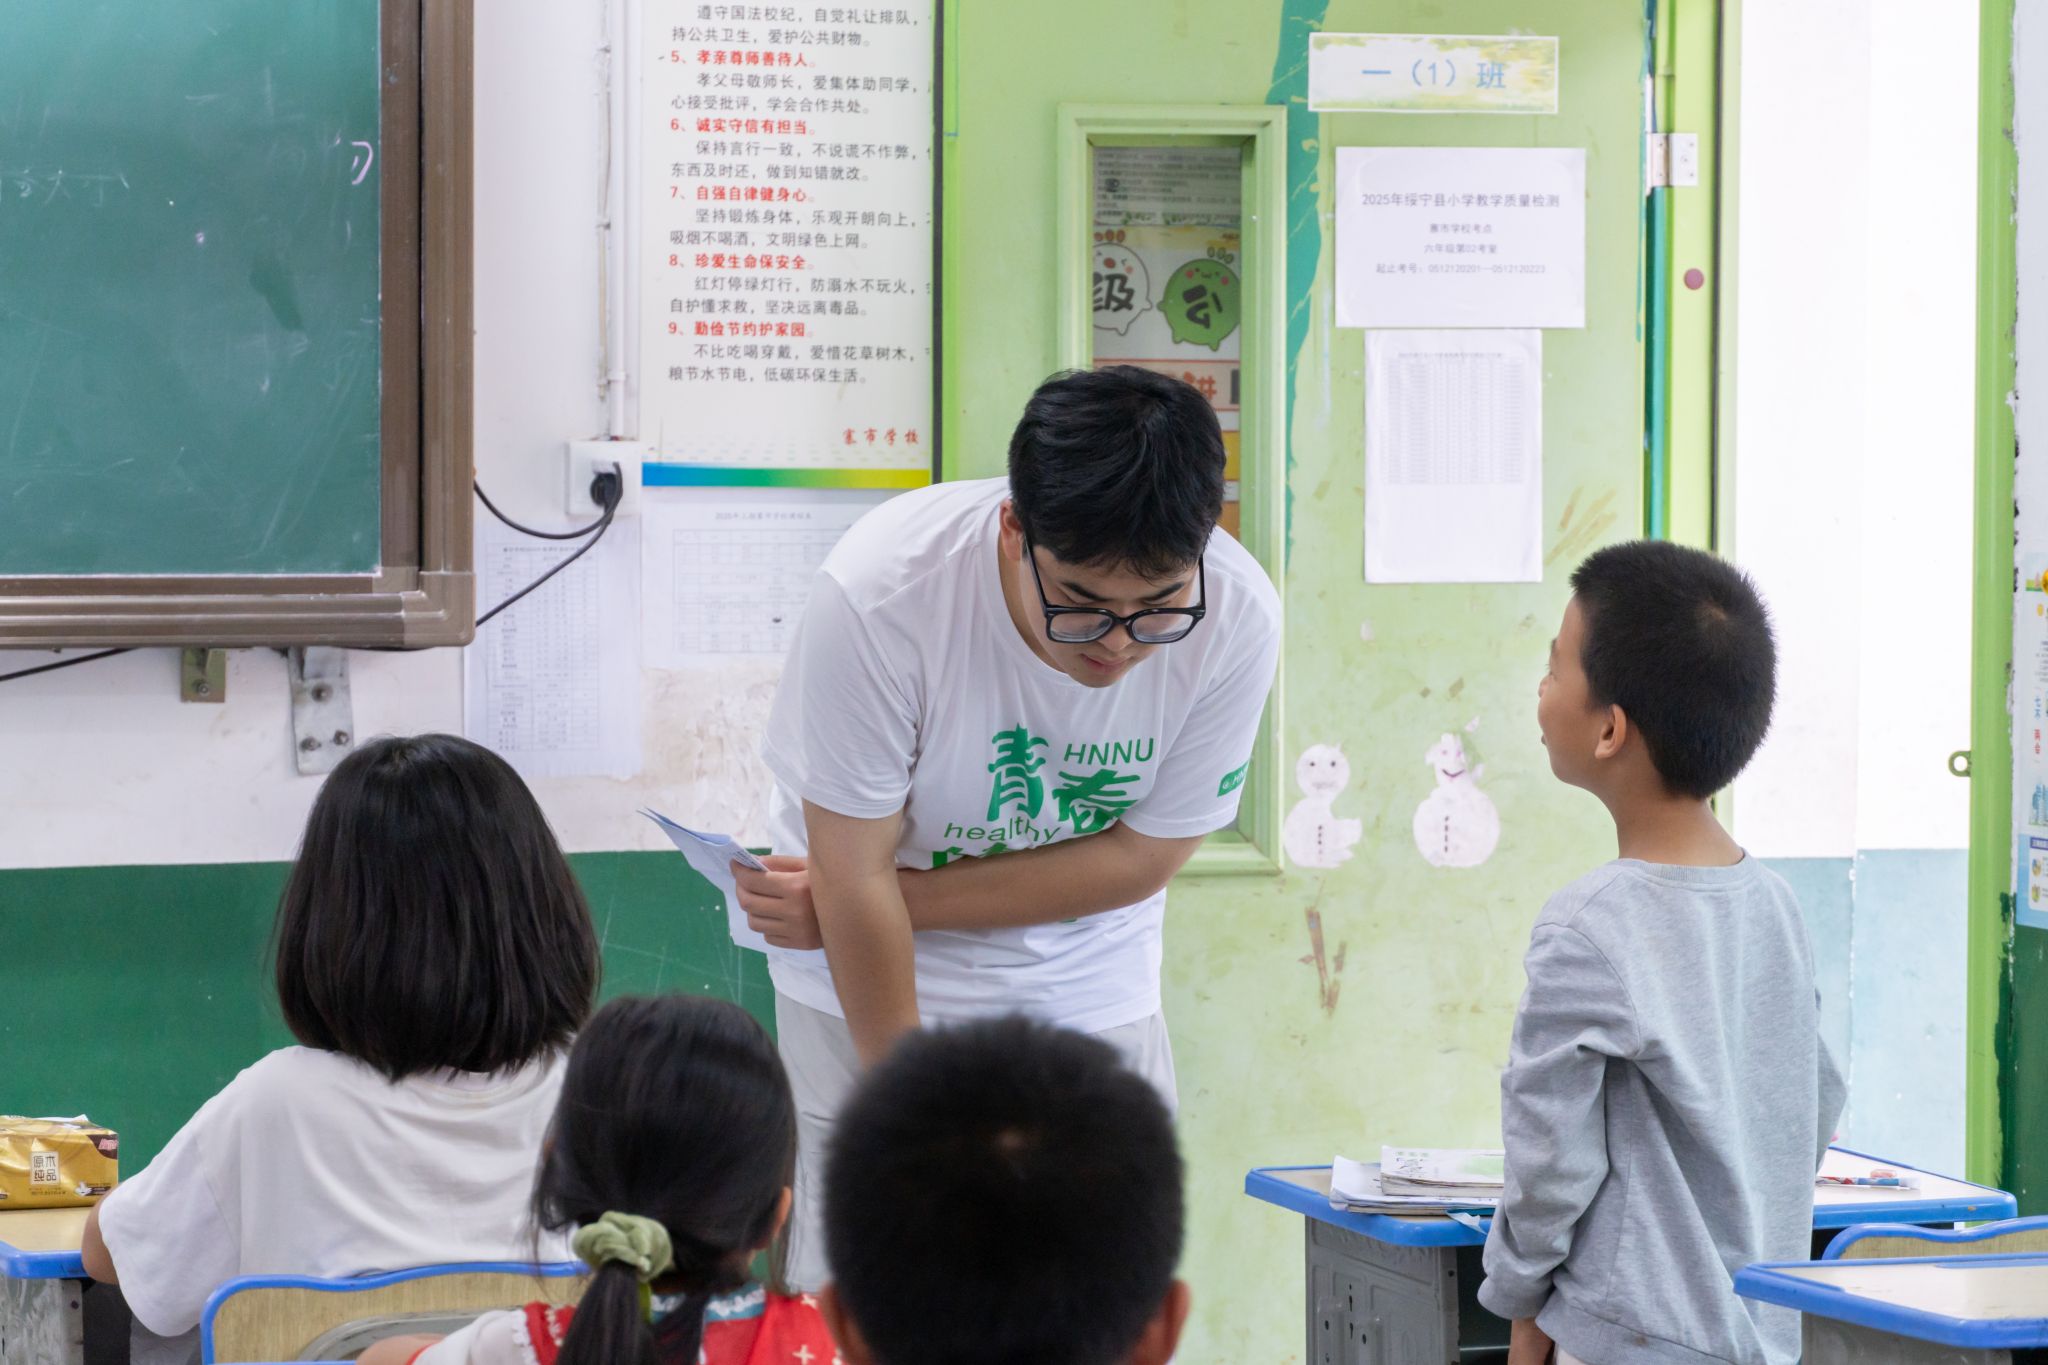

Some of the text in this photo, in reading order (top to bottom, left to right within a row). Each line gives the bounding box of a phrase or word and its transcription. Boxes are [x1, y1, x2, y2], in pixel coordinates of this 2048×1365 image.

[697, 5, 931, 26] 遵守国法校纪，自觉礼让排队，
[671, 27, 870, 47] 持公共卫生，爱护公共财物。
[697, 72, 931, 94] 孝父母敬师长，爱集体助同学，
[671, 95, 870, 115] 心接受批评，学会合作共处。
[670, 117, 816, 136] 6、诚实守信有担当。
[696, 140, 931, 161] 保持言行一致，不说谎不作弊，
[670, 162, 868, 182] 东西及时还，做到知错就改。
[670, 185, 815, 203] 7、自强自律健身心。
[1362, 192, 1560, 208] 2025年绥宁县小学教学质量检测
[695, 207, 931, 228] 坚持锻炼身体，乐观开朗向上，
[669, 230, 868, 249] 吸烟不喝酒，文明绿色上网。
[668, 253, 815, 271] 8、珍爱生命保安全。
[694, 276, 931, 296] 红灯停绿灯行，防溺水不玩火，
[669, 298, 868, 317] 自护懂求救，坚决远离毒品。
[668, 321, 814, 338] 9、勤俭节约护家园。
[694, 344, 931, 363] 不比吃喝穿戴，爱惜花草树木，
[668, 366, 867, 385] 粮节水节电，低碳环保生活。
[1063, 737, 1155, 766] HNNU
[943, 815, 1061, 844] healthy
